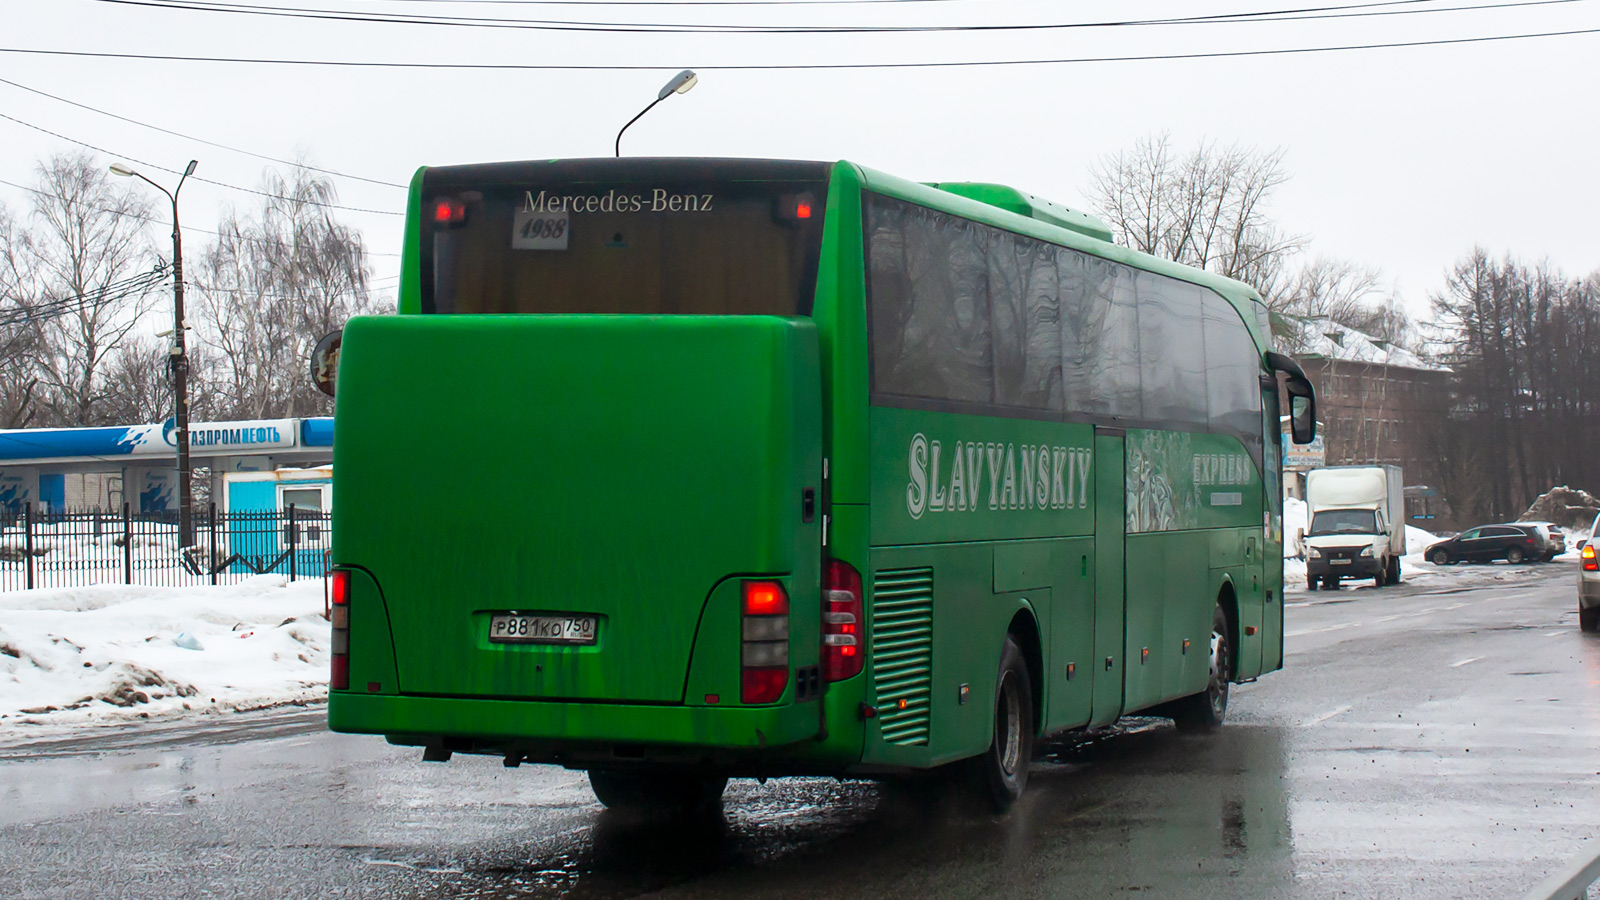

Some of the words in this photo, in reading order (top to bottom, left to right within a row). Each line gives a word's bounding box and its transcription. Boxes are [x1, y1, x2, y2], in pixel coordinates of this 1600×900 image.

[522, 188, 714, 213] Mercedes-Benz
[188, 426, 281, 447] АЗПРОМНЕФТЬ
[906, 432, 1092, 520] SLAVYANSKIY
[1193, 453, 1250, 486] EXPRESS
